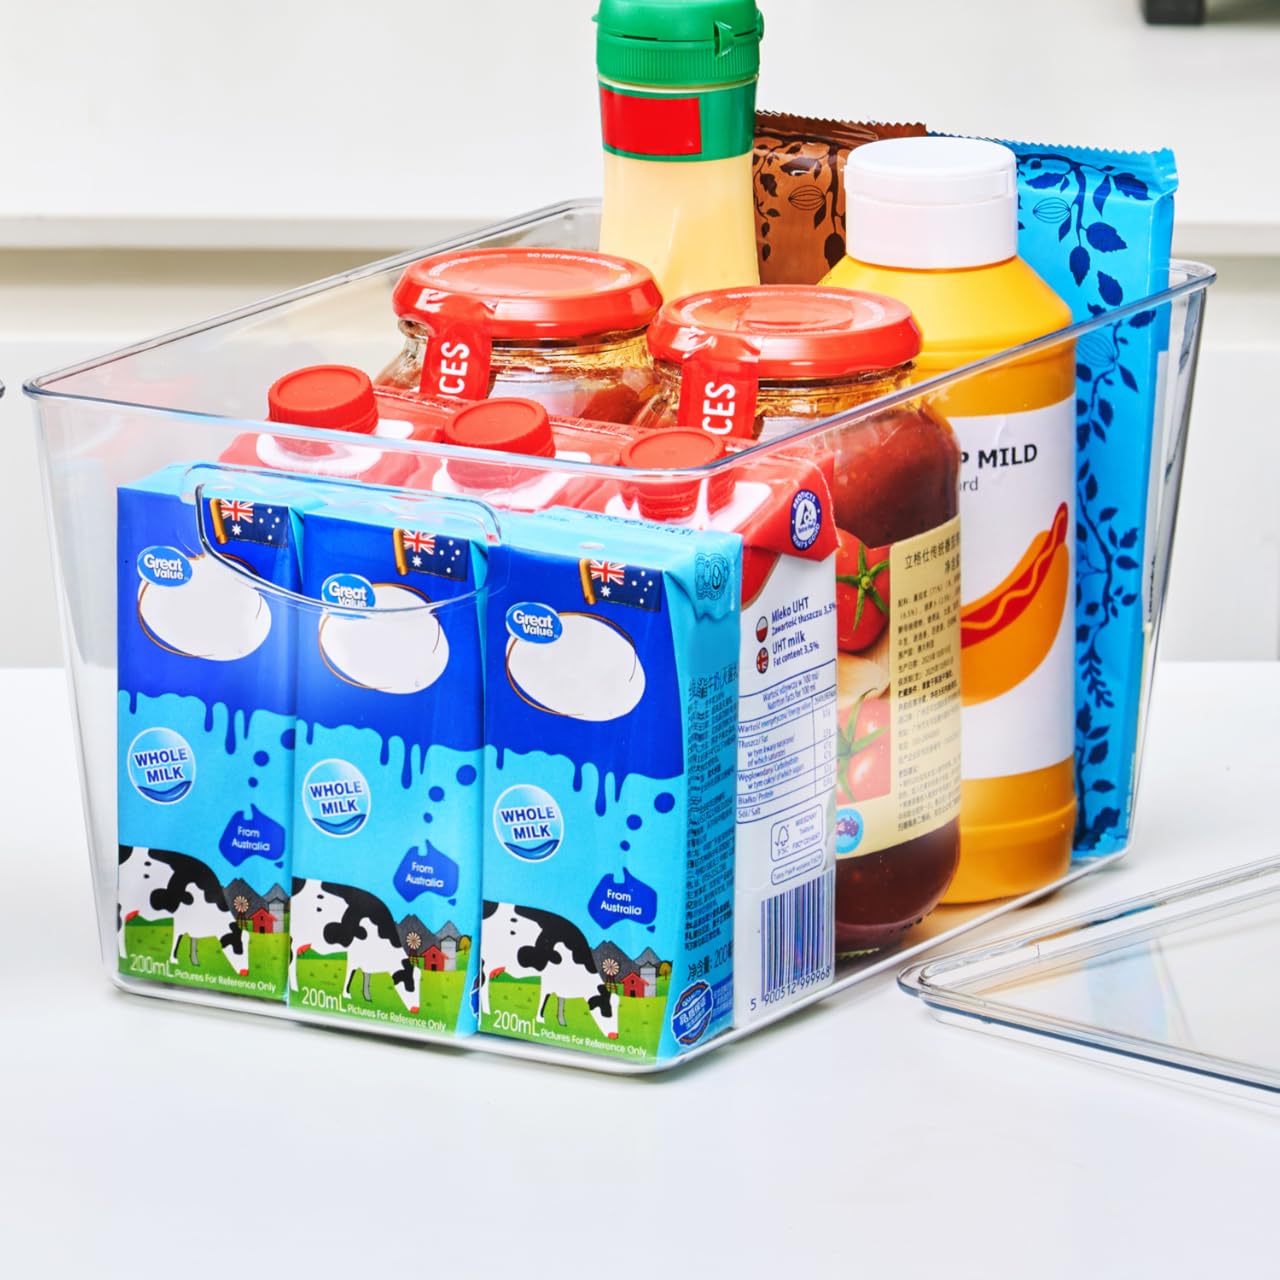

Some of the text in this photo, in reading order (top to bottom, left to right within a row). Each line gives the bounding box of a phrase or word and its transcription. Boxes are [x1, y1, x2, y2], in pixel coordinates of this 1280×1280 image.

[978, 444, 1037, 469] MILD
[144, 554, 182, 571] Great
[154, 568, 184, 579] Value
[329, 581, 366, 600] Great
[513, 610, 553, 628] Great
[772, 597, 808, 624] Mleko UHT
[522, 624, 553, 637] Value
[772, 630, 805, 654] UHT milk
[773, 641, 819, 667] Fat content 3,5%
[134, 747, 188, 767] WHOLE
[146, 766, 184, 783] MILK
[310, 781, 362, 800] WHOLE
[321, 799, 358, 816] MILK
[501, 806, 555, 823] WHOLE
[237, 825, 260, 838] From
[512, 824, 551, 840] MILK
[231, 837, 270, 852] Australia
[411, 861, 434, 874] From
[405, 873, 444, 888] Australia
[607, 888, 631, 902] From
[600, 901, 642, 915] Australia
[129, 954, 276, 993] 200mL Pictures For Reference Only
[763, 982, 796, 1006] 900512
[799, 967, 830, 990] 999968
[302, 987, 446, 1032] 200mL Pictures For Reference Only
[493, 1009, 647, 1057] 200mL Pictures For Reference Only
